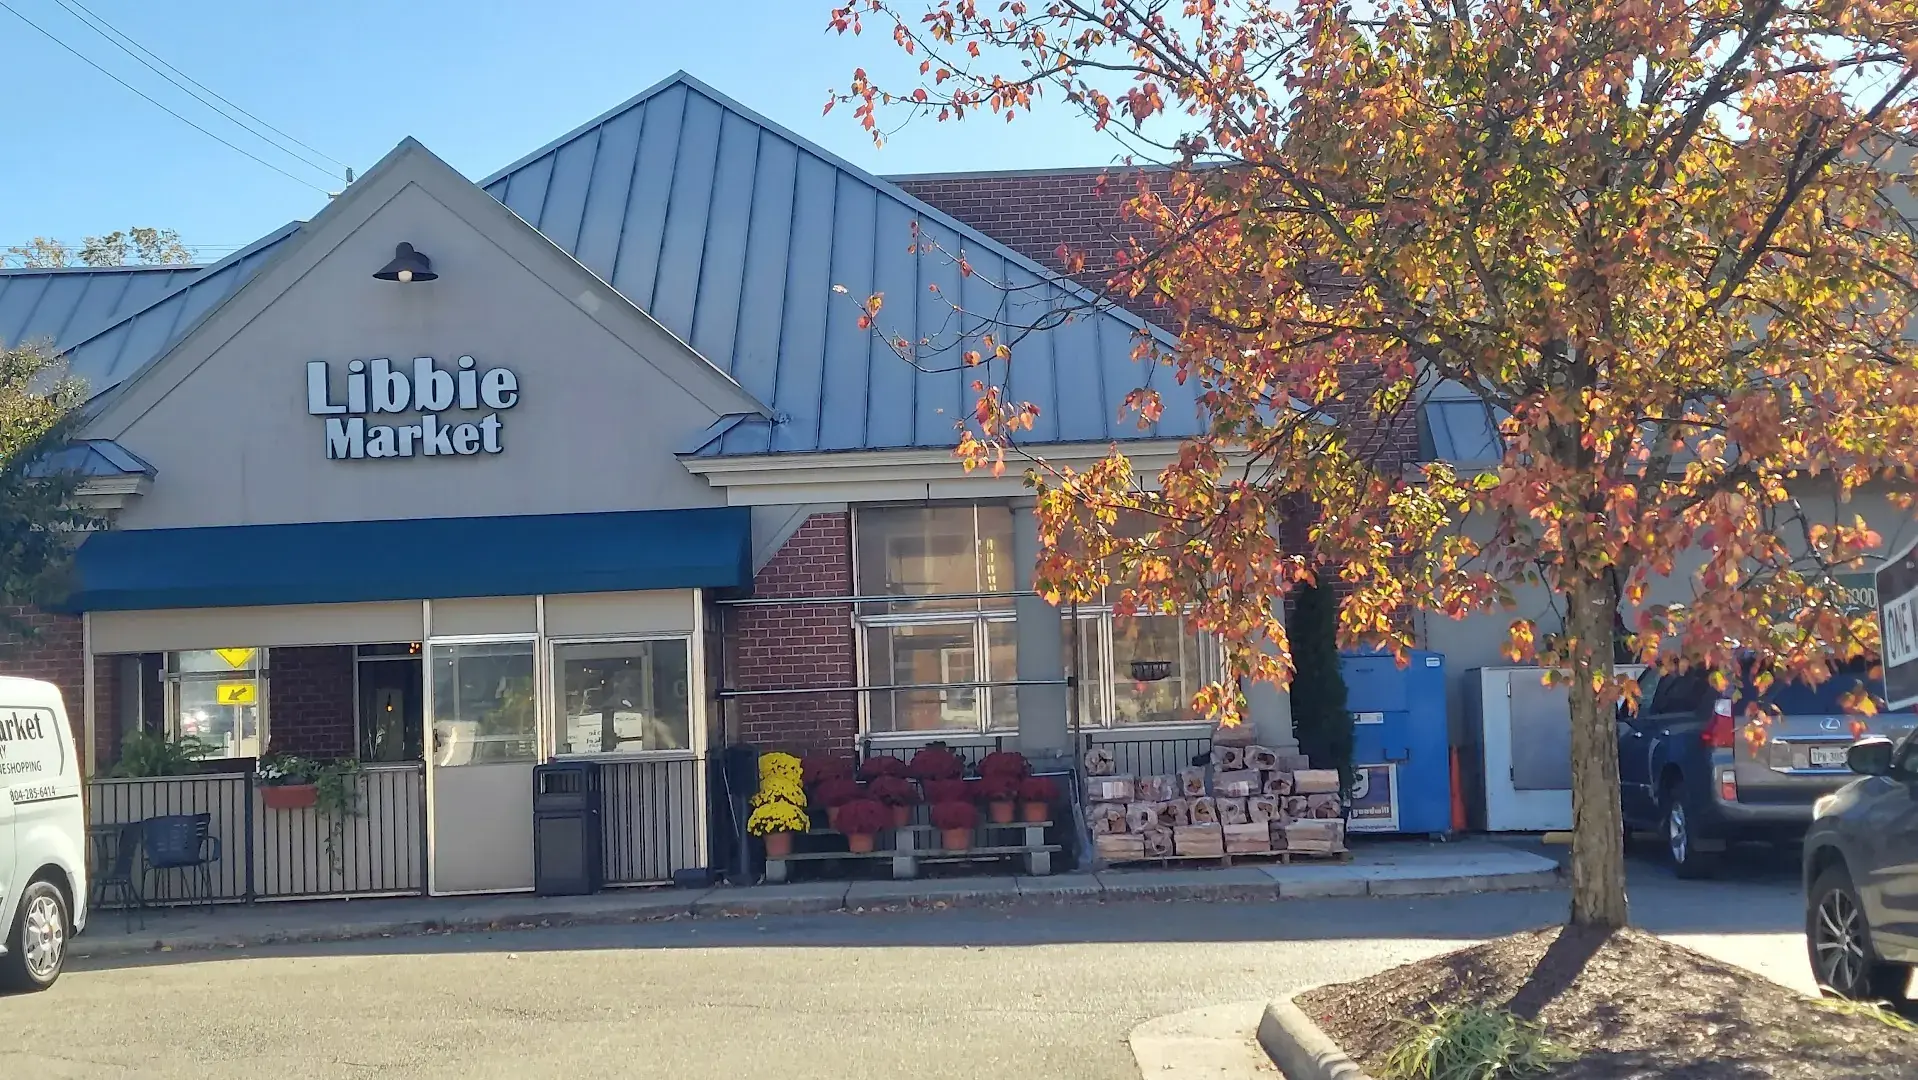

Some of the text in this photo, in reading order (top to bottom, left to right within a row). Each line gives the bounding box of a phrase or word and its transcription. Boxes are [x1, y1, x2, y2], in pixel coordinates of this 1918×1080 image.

[306, 354, 519, 415] Libbie
[325, 412, 504, 459] Market
[1887, 602, 1911, 660] ONE
[9, 785, 56, 802] 804-285-6414
